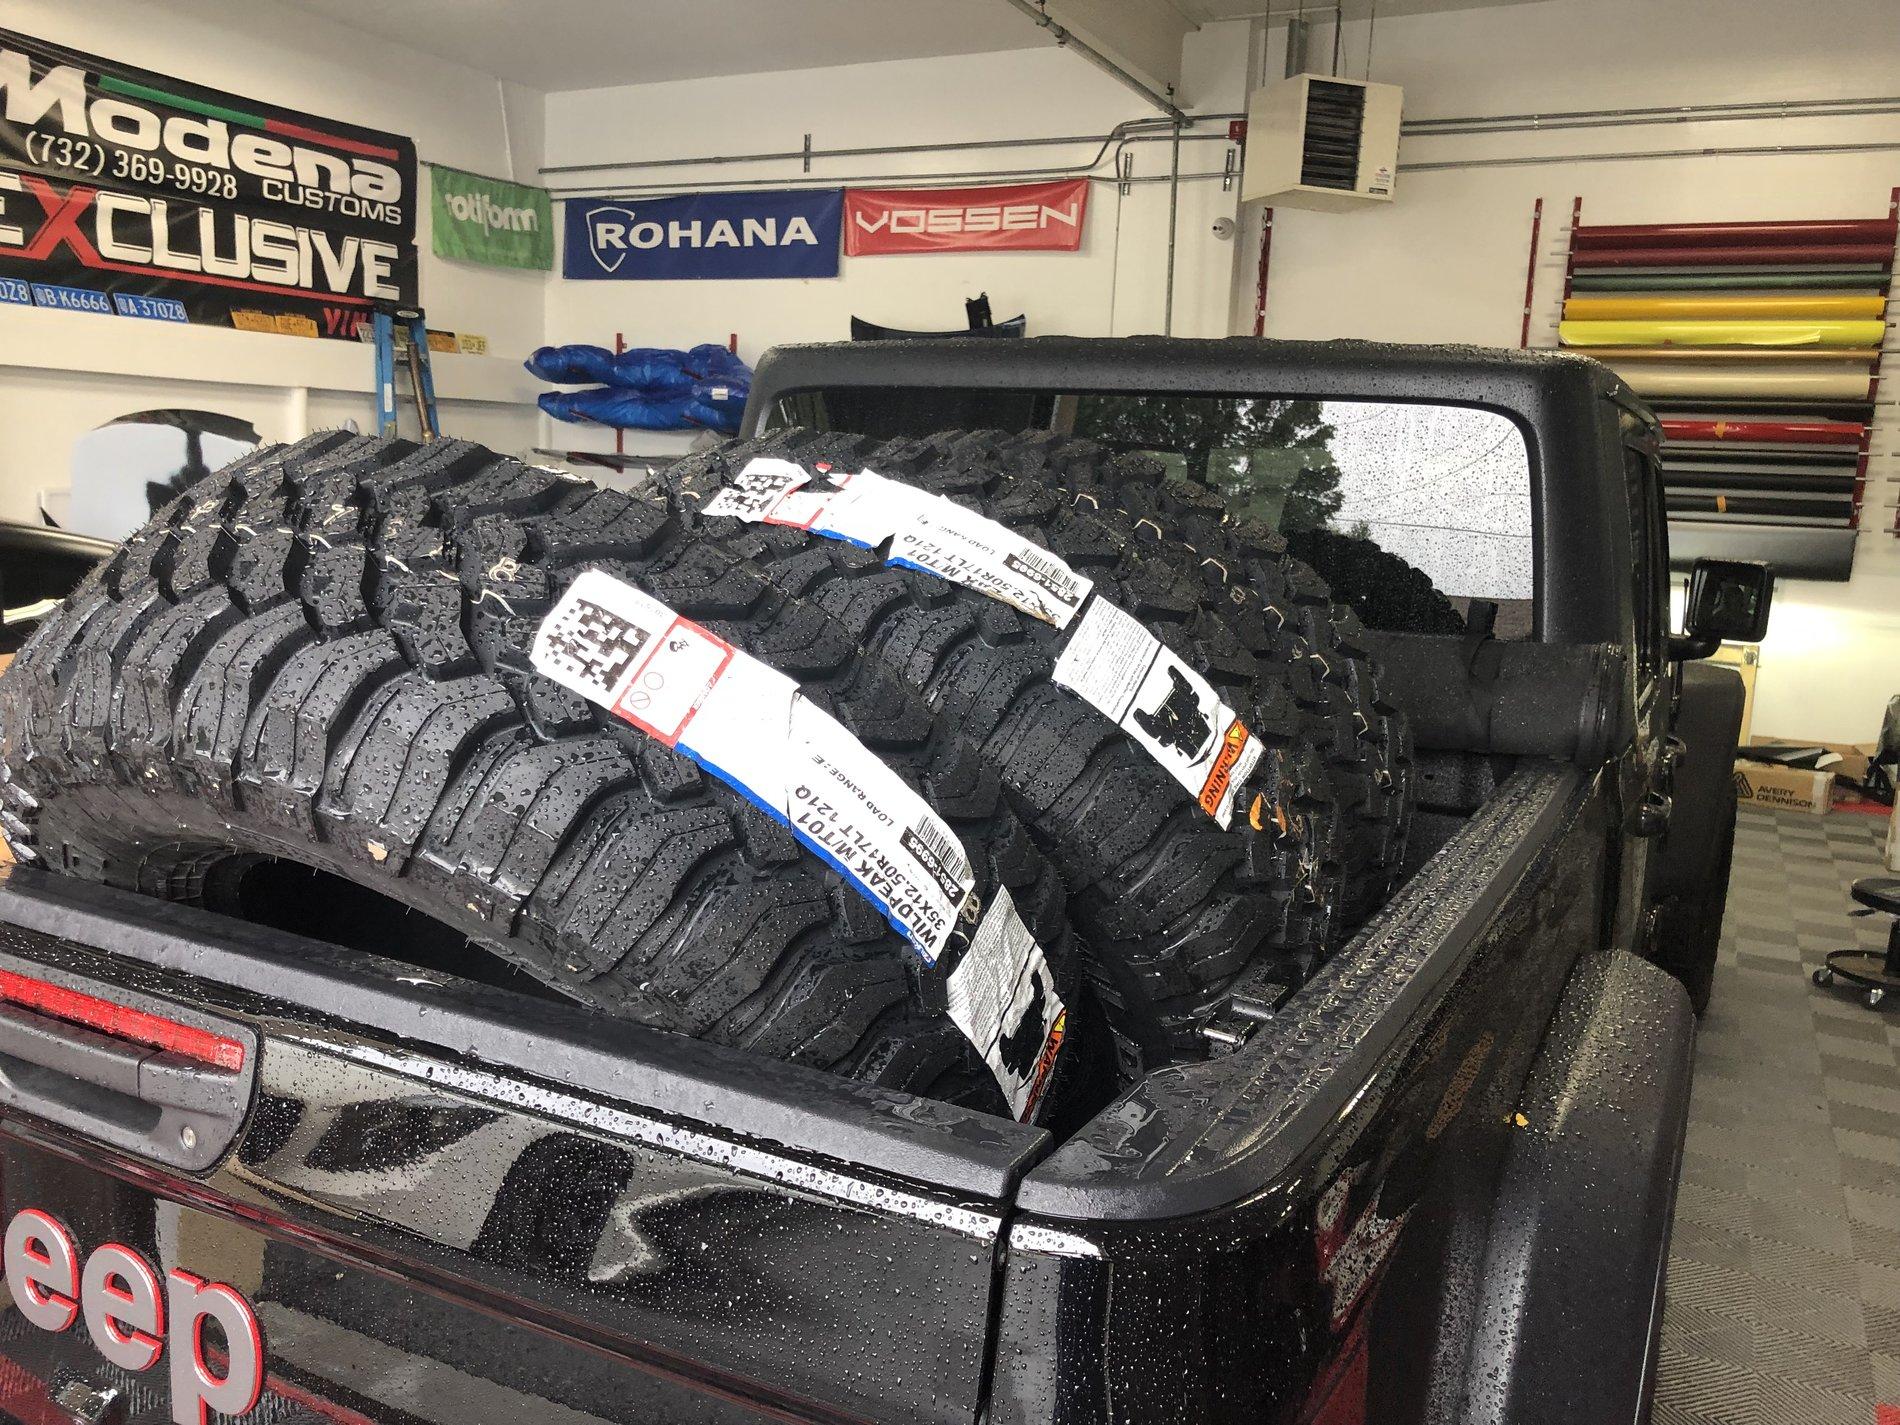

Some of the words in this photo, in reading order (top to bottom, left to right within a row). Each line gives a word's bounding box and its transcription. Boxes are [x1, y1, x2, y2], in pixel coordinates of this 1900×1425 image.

[0, 48, 401, 203] Modena
[25, 131, 105, 176] (732)
[113, 149, 238, 200] 369-9928
[262, 179, 401, 225] CUSTOMS
[856, 203, 1077, 233] VOSSEN
[597, 217, 818, 249] ROHANA
[903, 535, 942, 554] 121Q
[907, 549, 961, 577] MT01
[795, 784, 839, 822] 121Q
[1756, 795, 1817, 809] DENNISON
[1757, 785, 1796, 797] AVERY
[866, 800, 895, 826] LOAD
[797, 812, 858, 861] M/T01
[839, 825, 946, 931] 35X12.50R17LT
[907, 837, 960, 897] 2851-6995
[854, 859, 938, 949] WILDPEAK
[2, 1208, 263, 1425] eep
